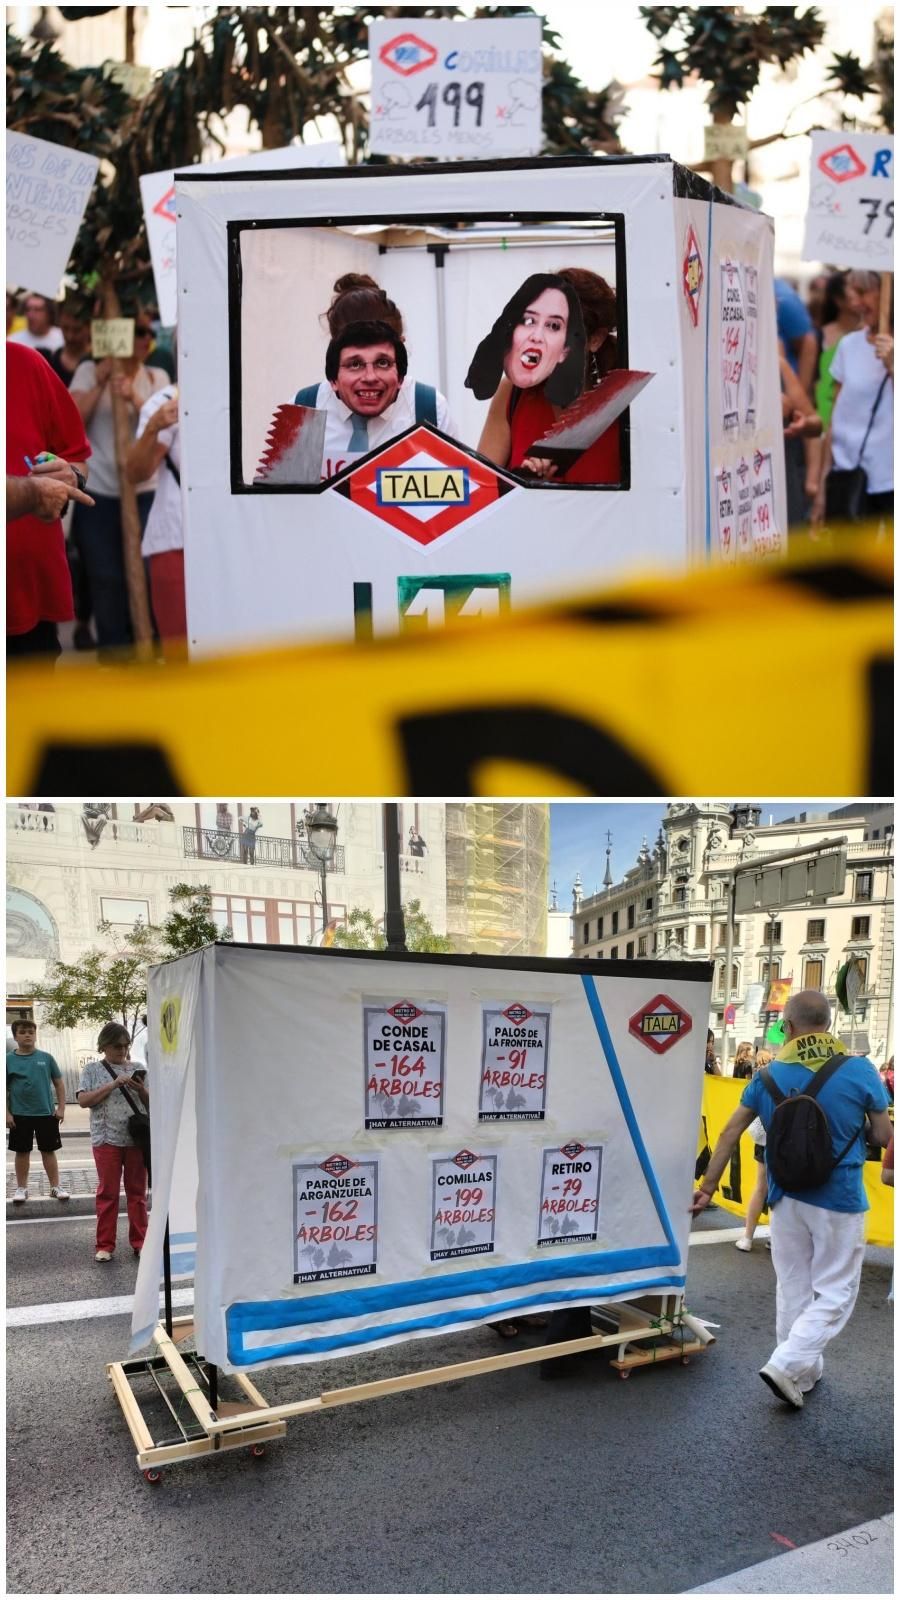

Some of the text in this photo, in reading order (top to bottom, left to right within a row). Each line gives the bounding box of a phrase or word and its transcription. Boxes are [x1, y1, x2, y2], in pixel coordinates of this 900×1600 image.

[416, 81, 485, 127] 199
[40, 151, 72, 178] DE
[859, 198, 894, 238] 79
[384, 474, 461, 499] TALA
[645, 1016, 677, 1031] TALA
[381, 1025, 429, 1038] CONDE
[494, 1027, 538, 1038] PALOS DE
[373, 1039, 437, 1052] DE CASAL
[488, 1038, 543, 1048] LA FRONTERA
[796, 1035, 817, 1050] NO
[797, 1046, 834, 1061] TALA
[482, 1067, 546, 1089] ÁRBOLES
[366, 1074, 444, 1098] ÁRBOLES
[369, 1118, 439, 1130] ¡HAY ALTERNATIVA!
[482, 1112, 541, 1122] ¡HAY ALTERNATIVA!
[552, 1161, 592, 1175] RETIRO
[306, 1178, 366, 1190] PARQUE DE
[437, 1172, 493, 1186] COMILLAS
[300, 1188, 372, 1201] ARGANZUELA
[541, 1196, 599, 1215] ÁRBOLES
[296, 1222, 378, 1245] ÁRBOLES
[433, 1243, 490, 1260] ¡HAY ALTERNATIVA!
[298, 1265, 371, 1284] ¡HAY ALTERNATIVA!
[826, 1530, 878, 1558] 3402
